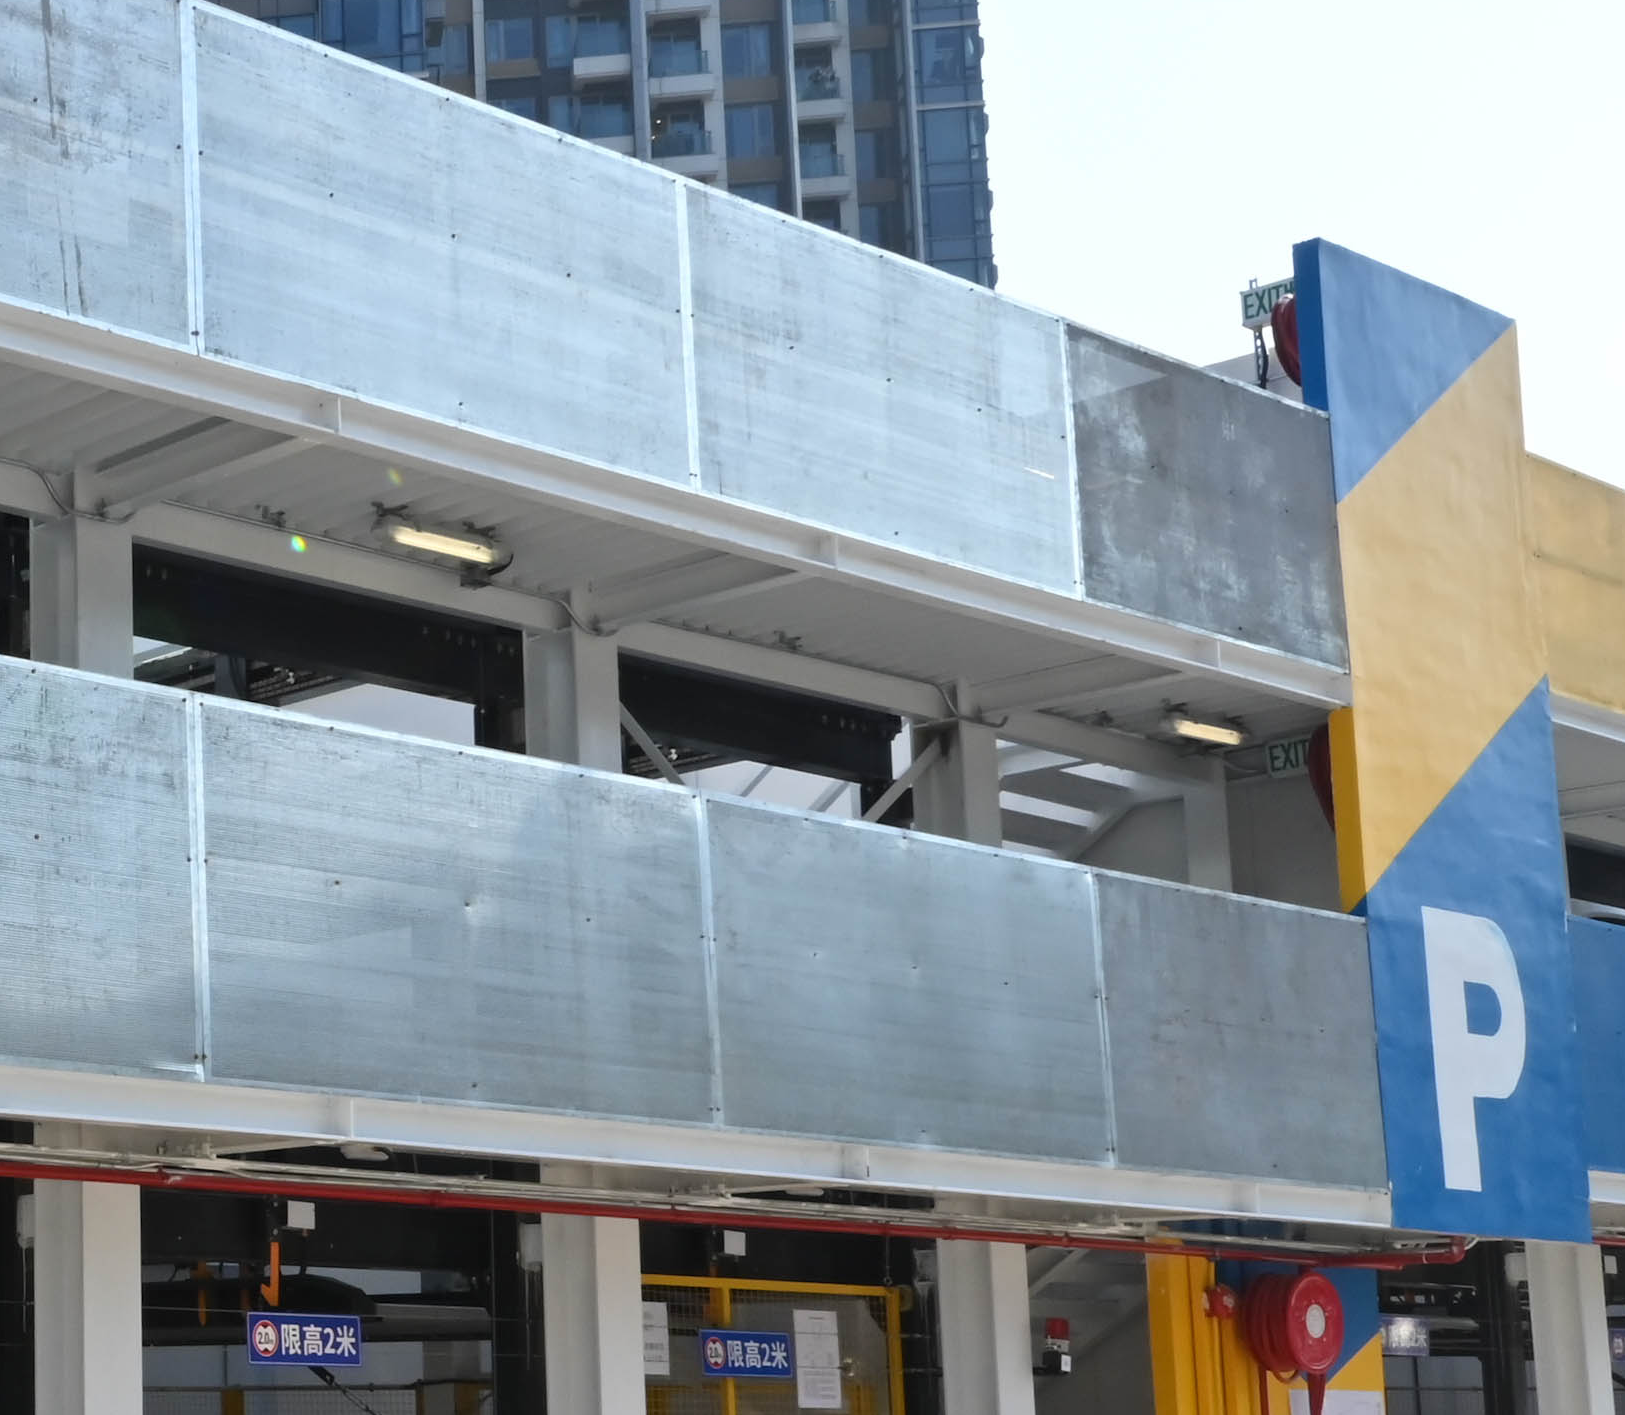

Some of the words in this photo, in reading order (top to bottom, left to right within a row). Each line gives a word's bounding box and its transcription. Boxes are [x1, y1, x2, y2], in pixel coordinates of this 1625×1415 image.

[1421, 905, 1526, 1192] P
[280, 1323, 357, 1357] 限高2米
[726, 1340, 789, 1369] 限高2米
